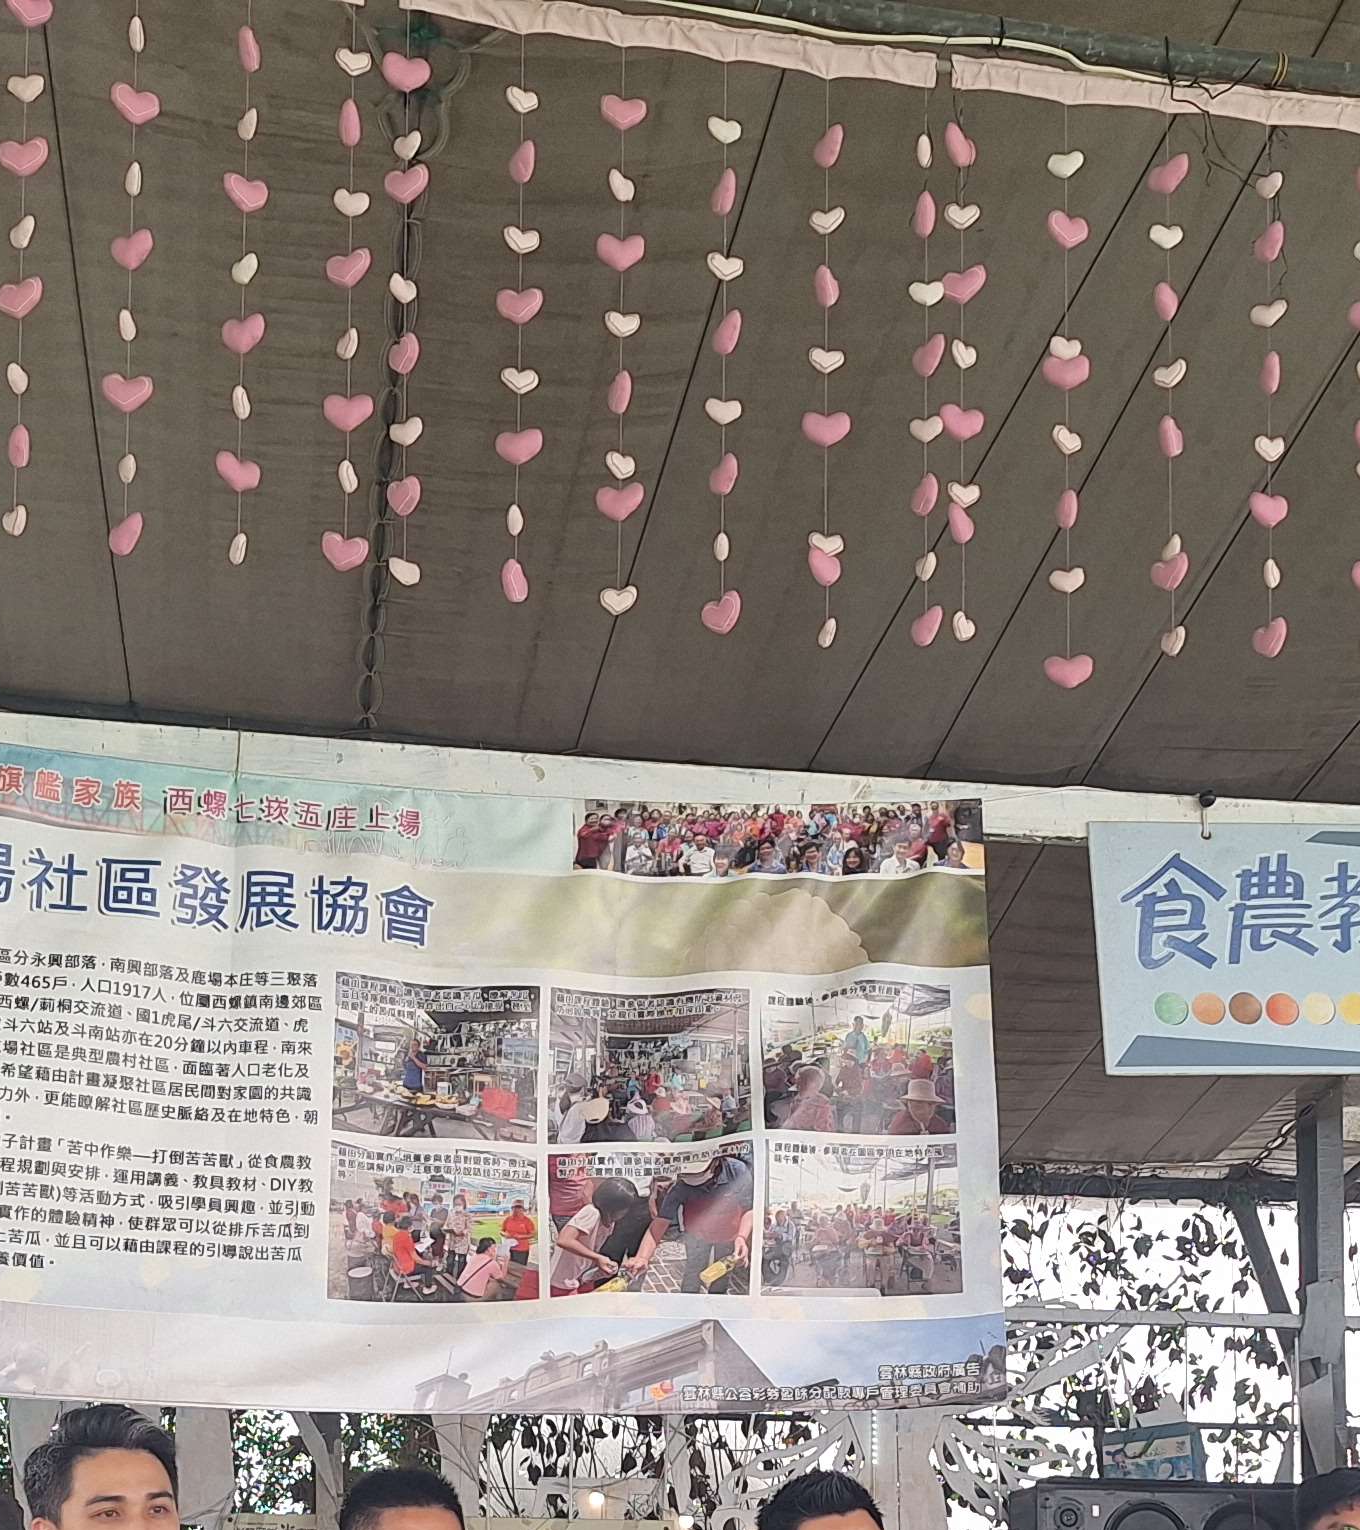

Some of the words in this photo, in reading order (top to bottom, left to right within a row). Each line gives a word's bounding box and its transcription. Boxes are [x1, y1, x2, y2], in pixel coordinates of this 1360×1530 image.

[165, 787, 421, 838] 西螺七崁五庄上場
